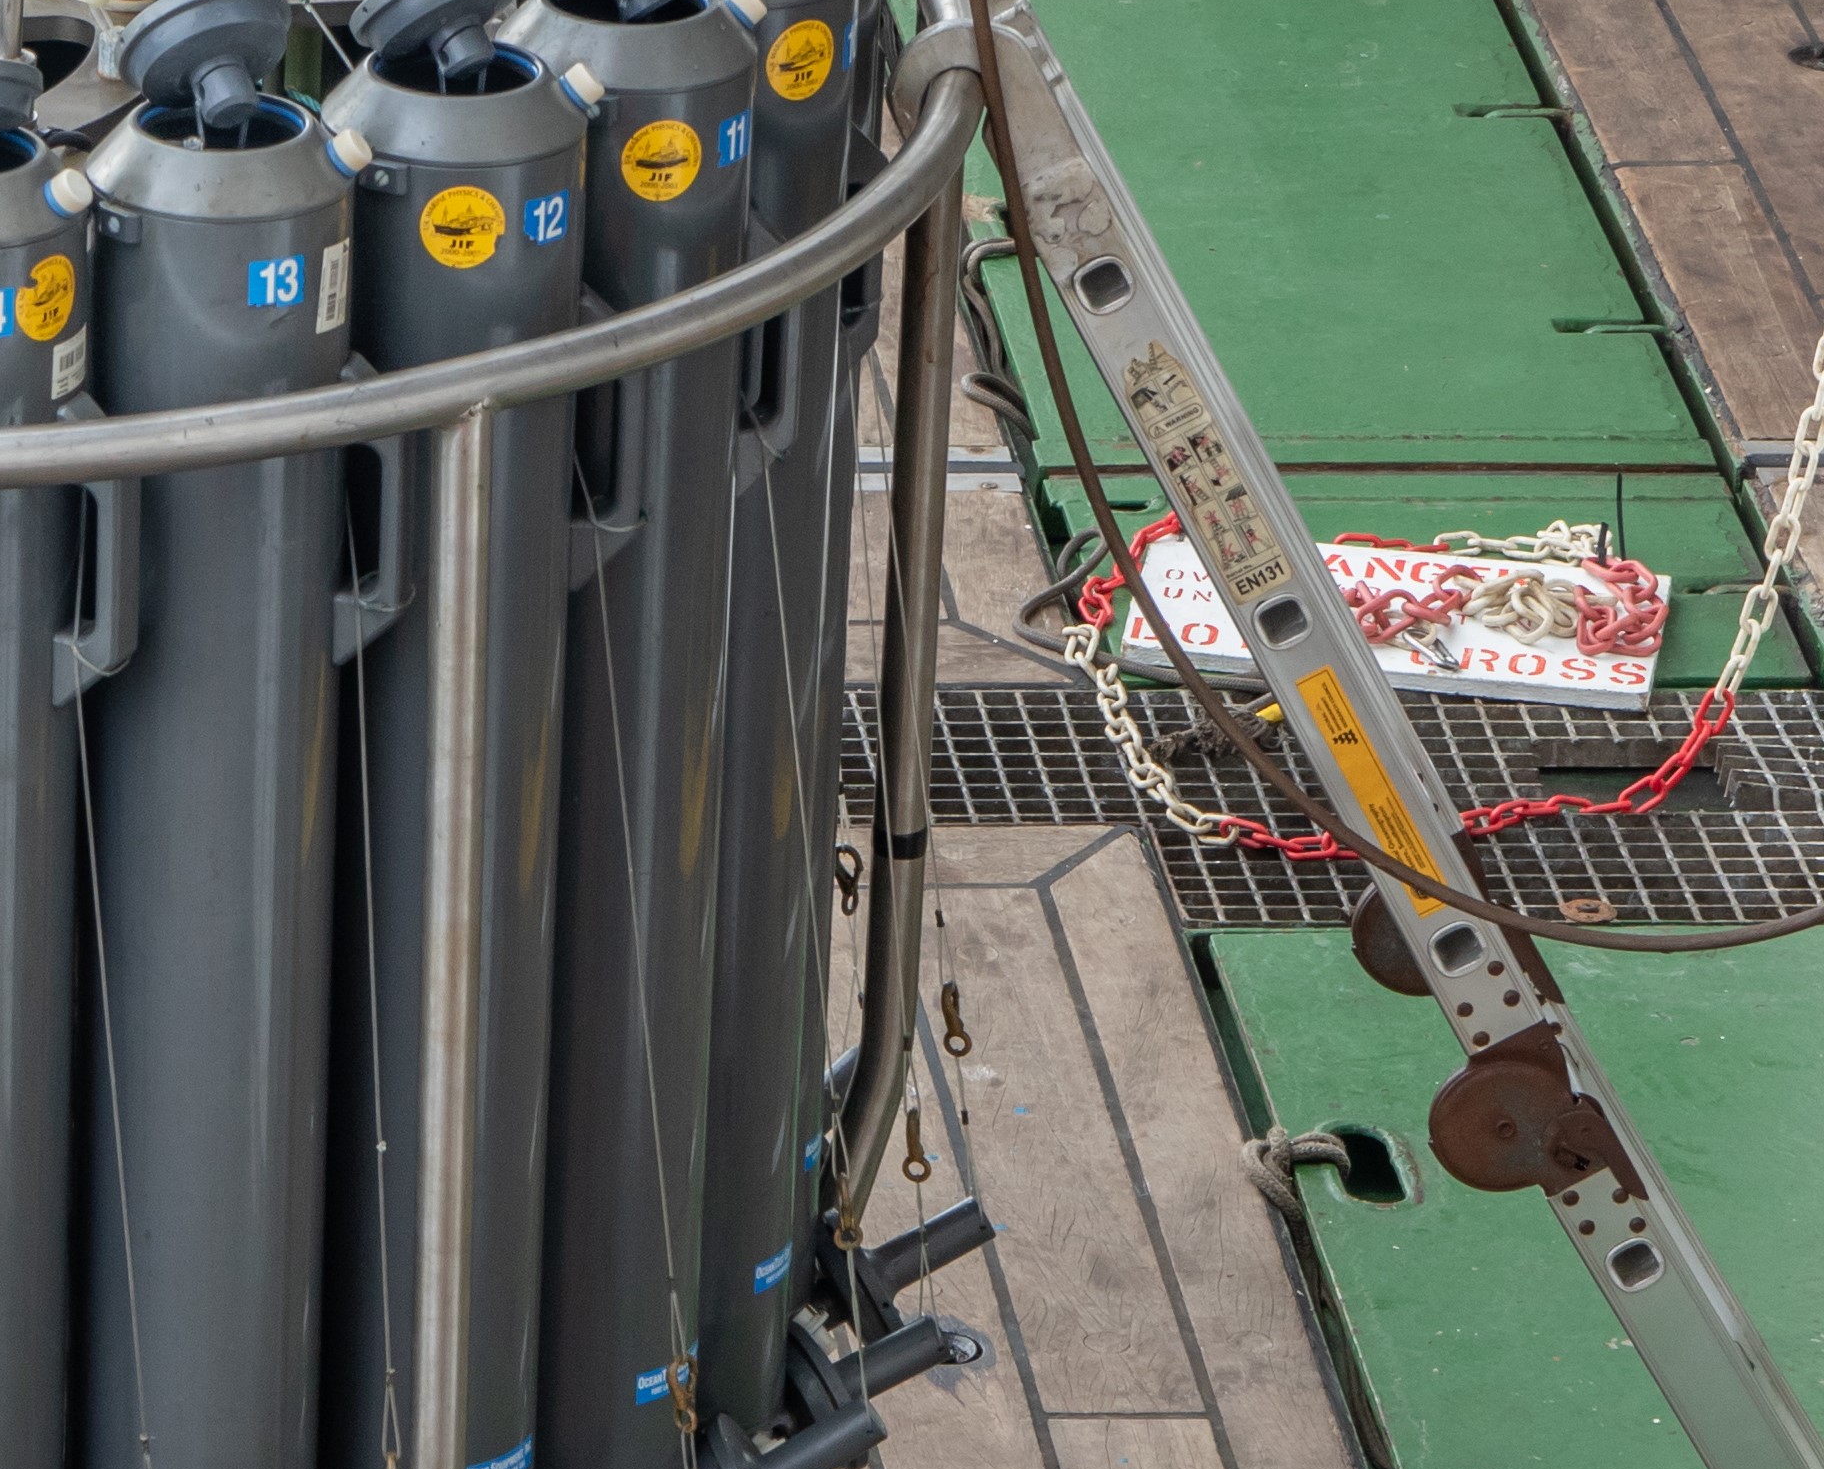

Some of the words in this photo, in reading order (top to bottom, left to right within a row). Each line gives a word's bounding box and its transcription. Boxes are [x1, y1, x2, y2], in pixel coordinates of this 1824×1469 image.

[794, 70, 813, 82] JIF
[727, 116, 745, 161] 11
[649, 173, 673, 182] JIF
[448, 190, 478, 198] PHYSICS
[533, 196, 564, 242] 12
[449, 240, 474, 249] JIF
[260, 259, 298, 303] 13
[42, 307, 59, 323] JIF
[1165, 407, 1199, 430] WARNING
[1235, 561, 1285, 596] EN131
